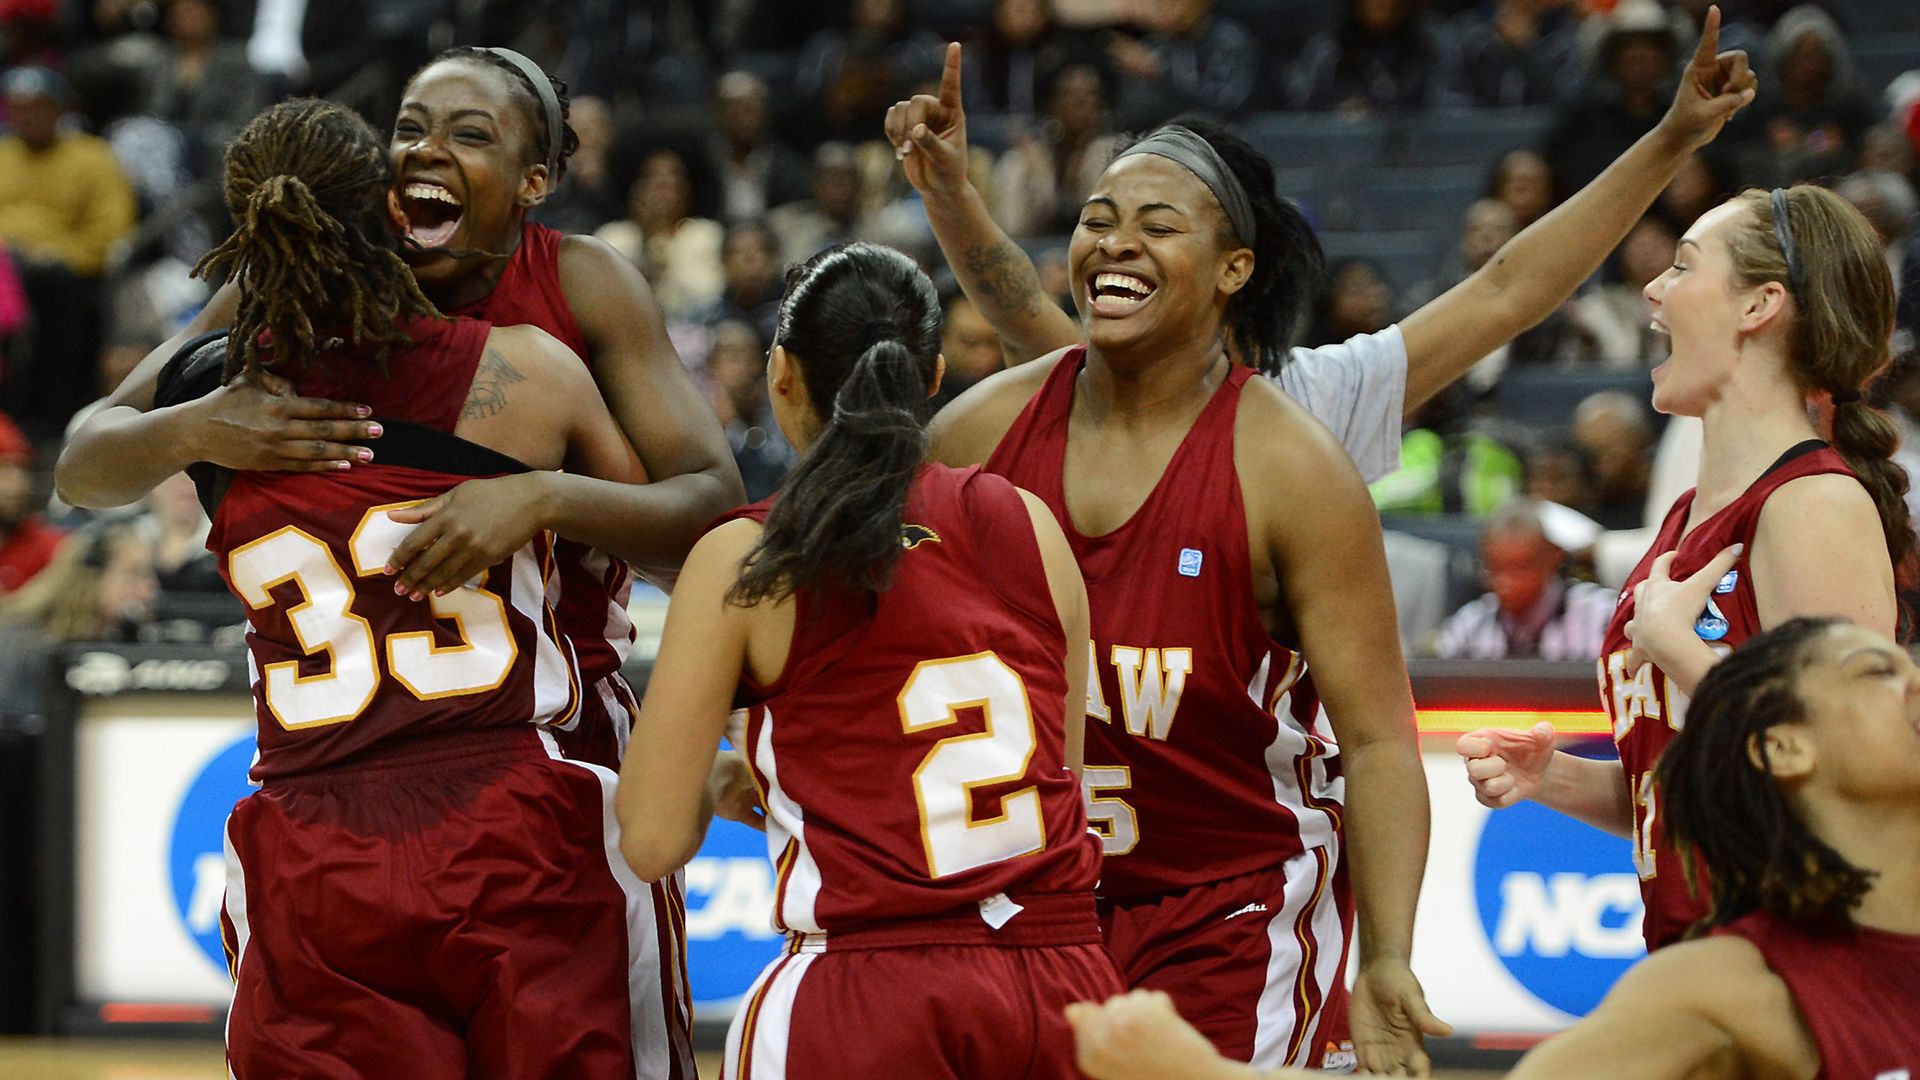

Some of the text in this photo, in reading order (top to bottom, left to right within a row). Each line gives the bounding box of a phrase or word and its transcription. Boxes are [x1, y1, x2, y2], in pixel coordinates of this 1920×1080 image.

[229, 499, 518, 731] 33
[896, 650, 1046, 879] 2
[1494, 870, 1649, 958] NC
